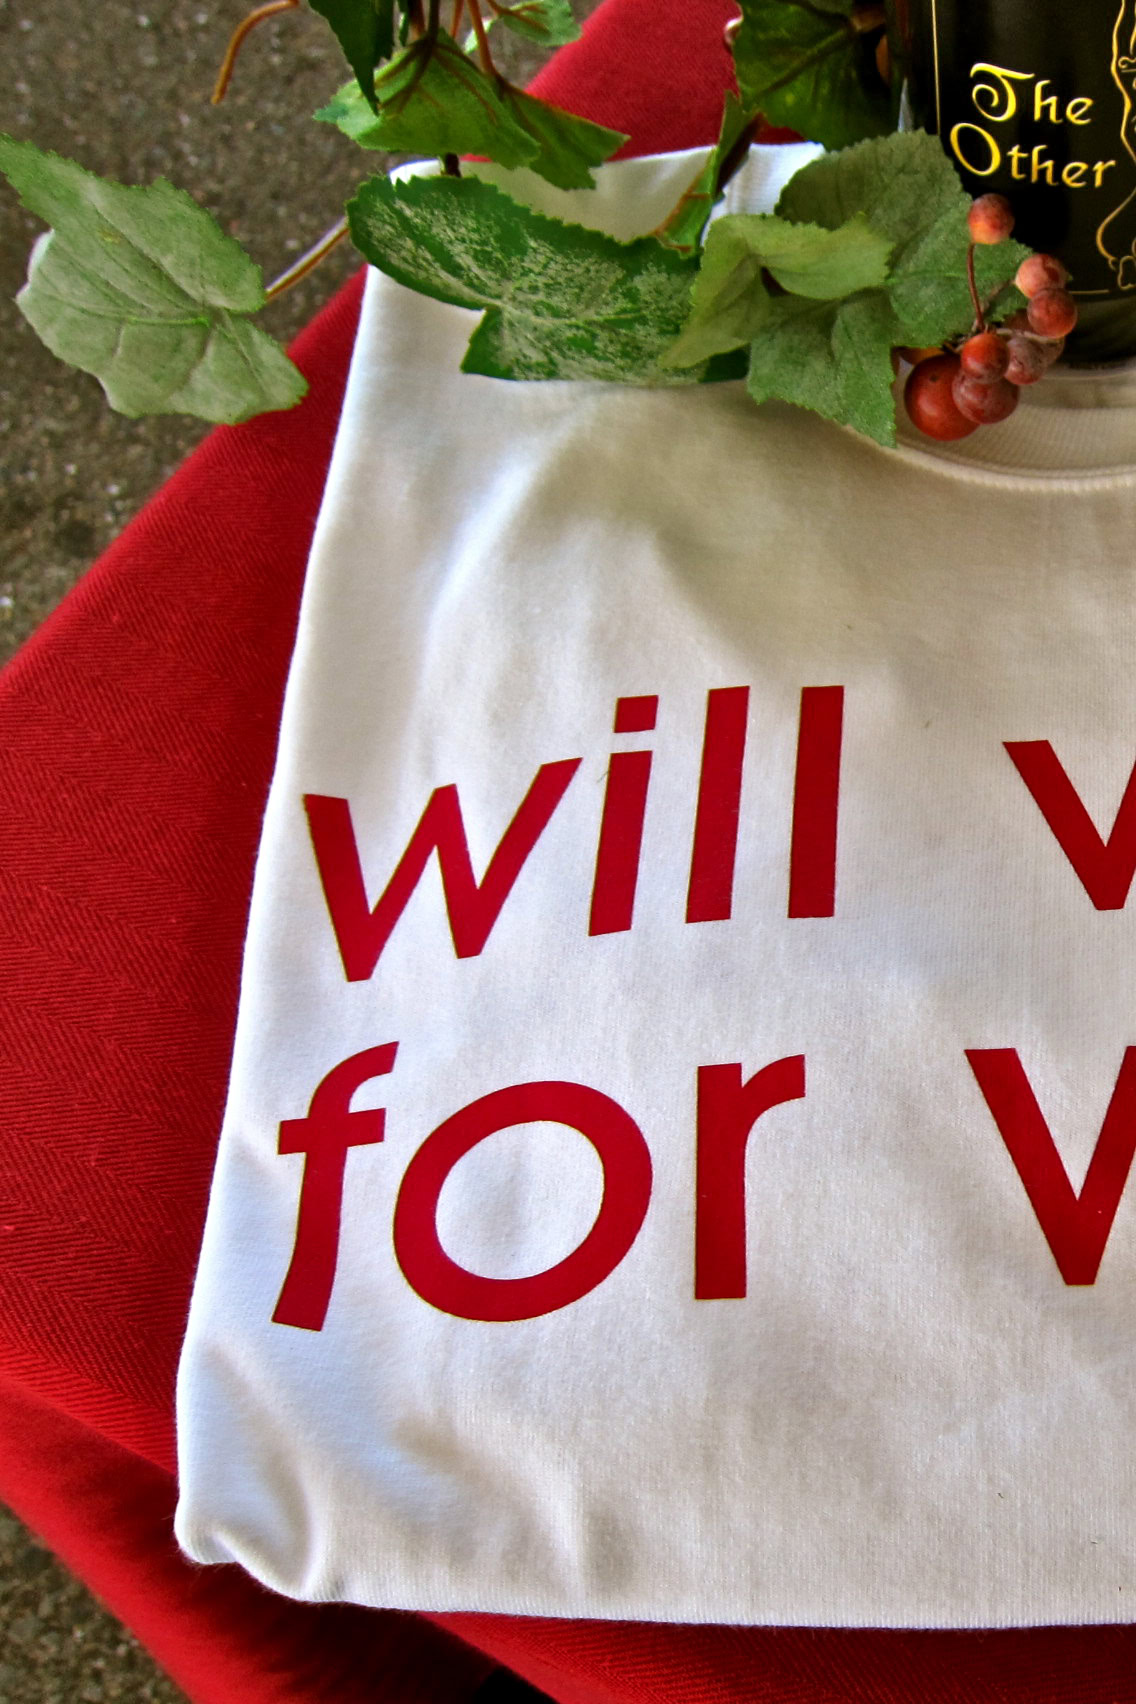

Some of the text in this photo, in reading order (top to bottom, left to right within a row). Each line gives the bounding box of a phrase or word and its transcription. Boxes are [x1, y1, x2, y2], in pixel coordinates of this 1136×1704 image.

[950, 122, 1117, 189] Other
[969, 62, 1094, 125] The
[303, 684, 845, 983] will
[270, 1040, 807, 1333] for
